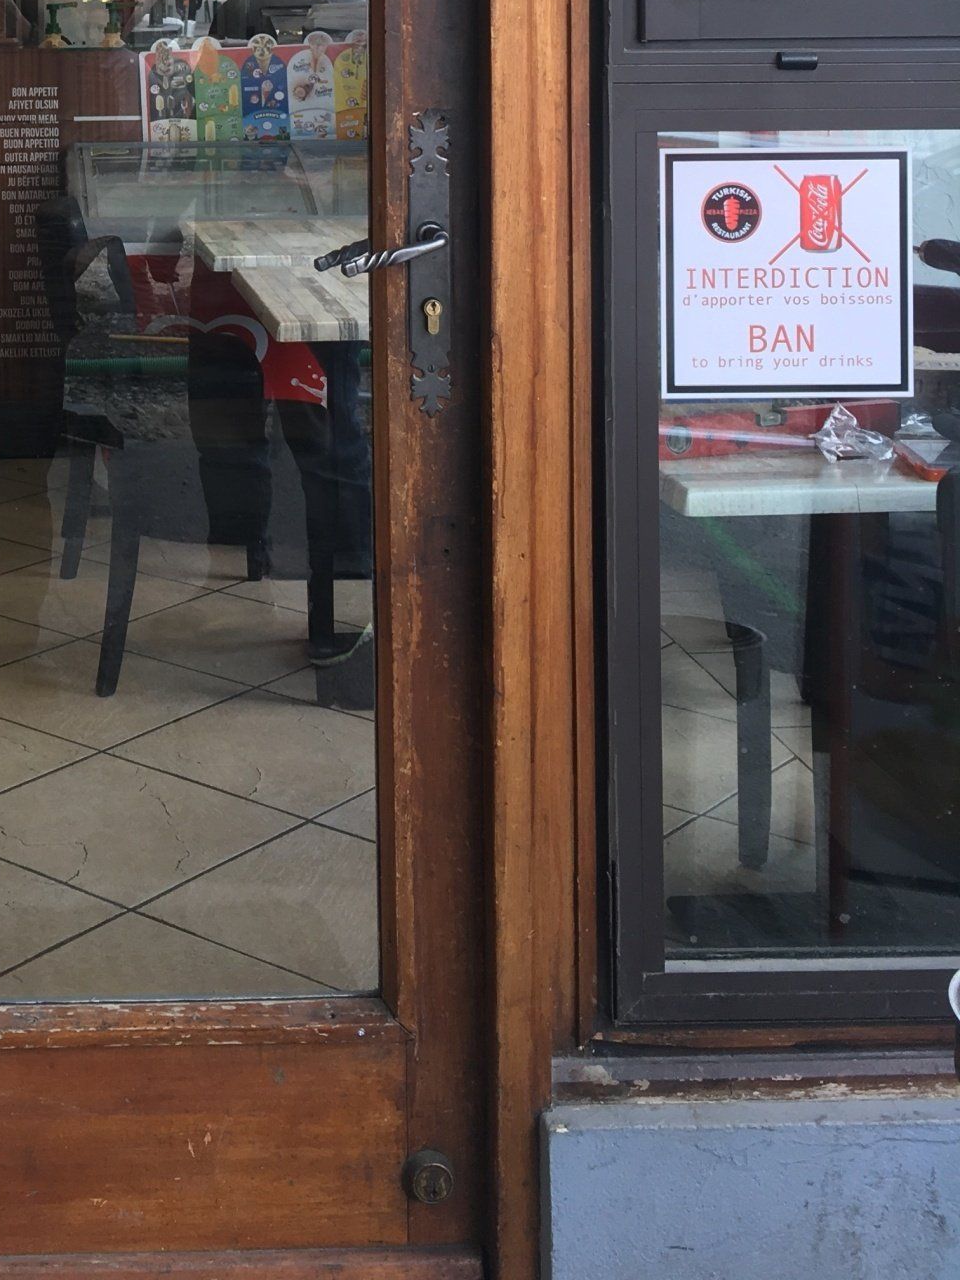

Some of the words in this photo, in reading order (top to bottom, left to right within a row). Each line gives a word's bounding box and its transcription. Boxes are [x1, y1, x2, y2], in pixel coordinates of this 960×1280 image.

[12, 87, 27, 97] BON
[29, 86, 58, 97] APPETIT
[8, 100, 33, 110] AFIYET
[35, 100, 59, 110] OLSUN
[38, 114, 59, 124] MEAL
[0, 128, 19, 138] BUEN
[21, 127, 59, 138] PROVECHO
[3, 139, 23, 149] BUON
[25, 138, 60, 149] APPETITO
[4, 153, 28, 162] GUTER
[30, 152, 59, 162] APPETIT
[711, 187, 752, 202] TURKISH
[711, 222, 752, 240] RESTAURANT
[686, 267, 889, 290] INTERDICTION
[682, 294, 773, 309] d'apporter
[784, 296, 810, 306] vos
[820, 293, 893, 306] boissons
[749, 324, 815, 353] BAN
[692, 356, 708, 369] to
[718, 356, 764, 370] bring
[773, 356, 809, 370] your
[819, 355, 874, 368] drinks
